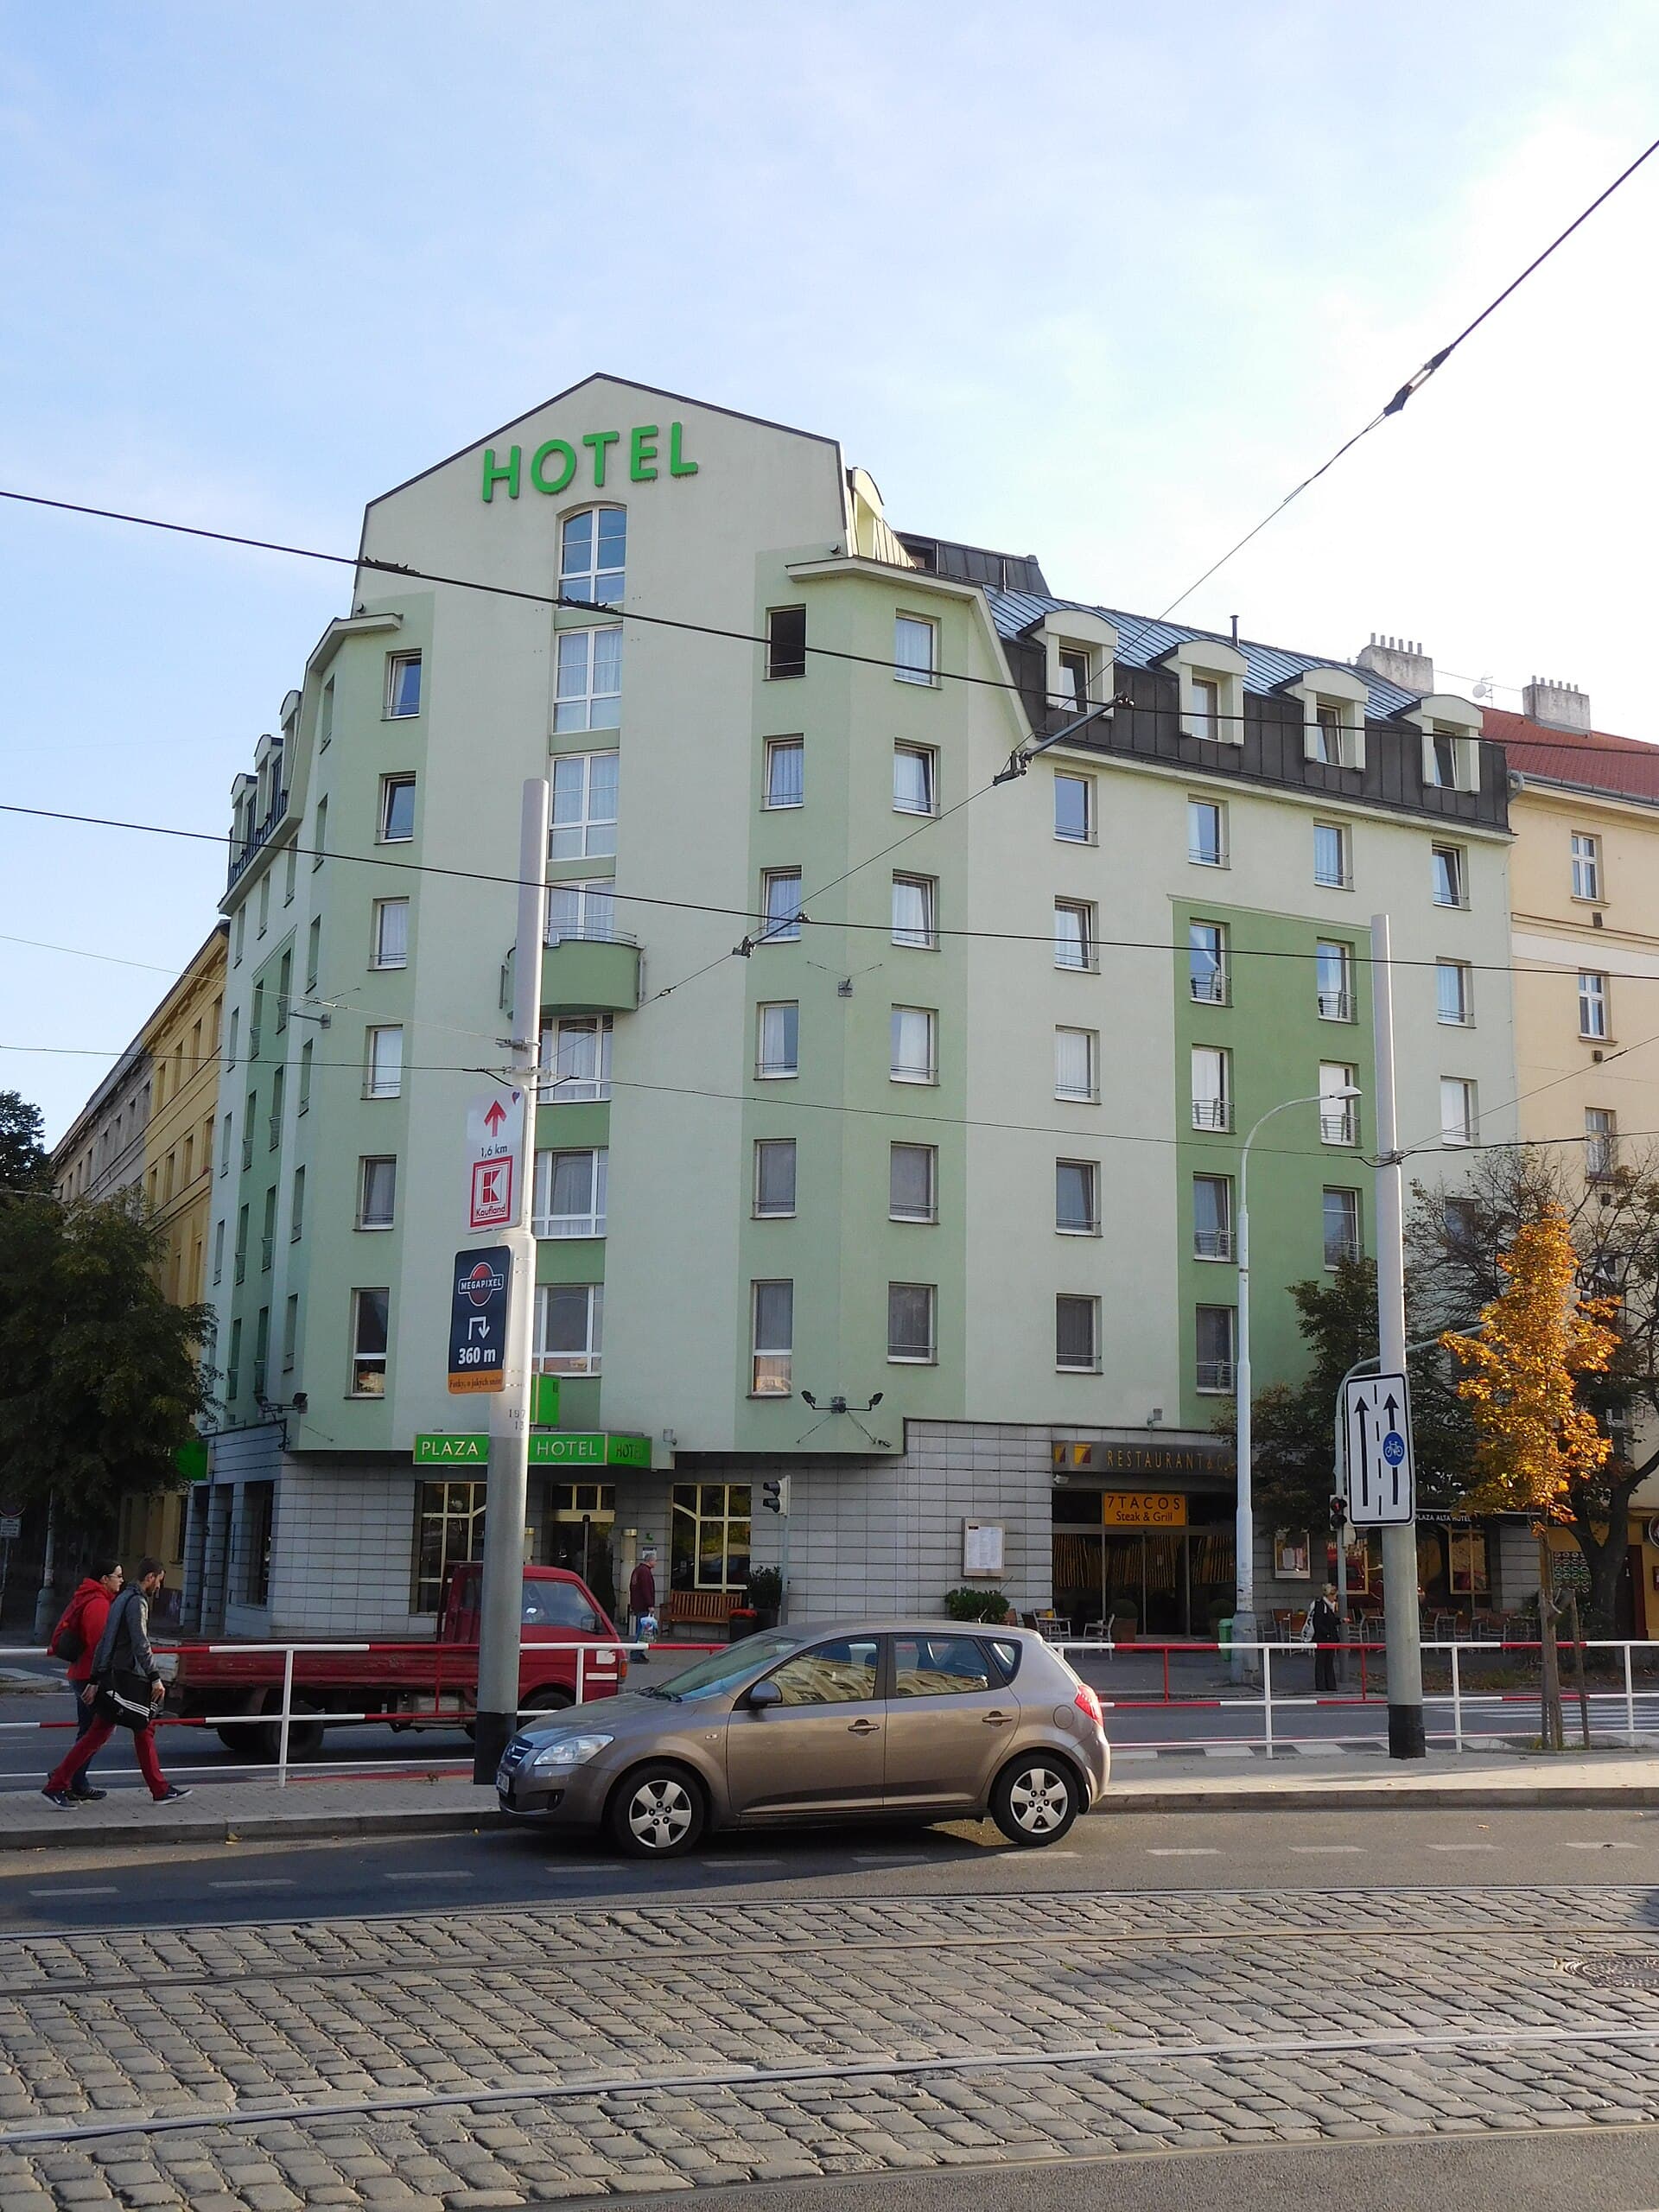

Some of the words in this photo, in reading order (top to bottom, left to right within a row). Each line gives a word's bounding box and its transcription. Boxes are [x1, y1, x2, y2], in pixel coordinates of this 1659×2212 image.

[482, 422, 699, 503] HOTEL
[480, 1146, 493, 1159] 1,6
[495, 1144, 508, 1154] km
[475, 1204, 505, 1217] Kaufland
[461, 1277, 502, 1291] MEGAPIXEL
[458, 1346, 480, 1365] 360
[483, 1348, 496, 1363] m
[421, 1440, 479, 1457] PLAZA
[537, 1440, 598, 1457] HOTEL
[1107, 1450, 1203, 1470] RESTAURANT
[1107, 1496, 1115, 1509] 7
[1118, 1496, 1180, 1510] TACOS
[1116, 1510, 1140, 1522] Steak
[1142, 1512, 1151, 1522] &
[1153, 1511, 1173, 1522] Grill
